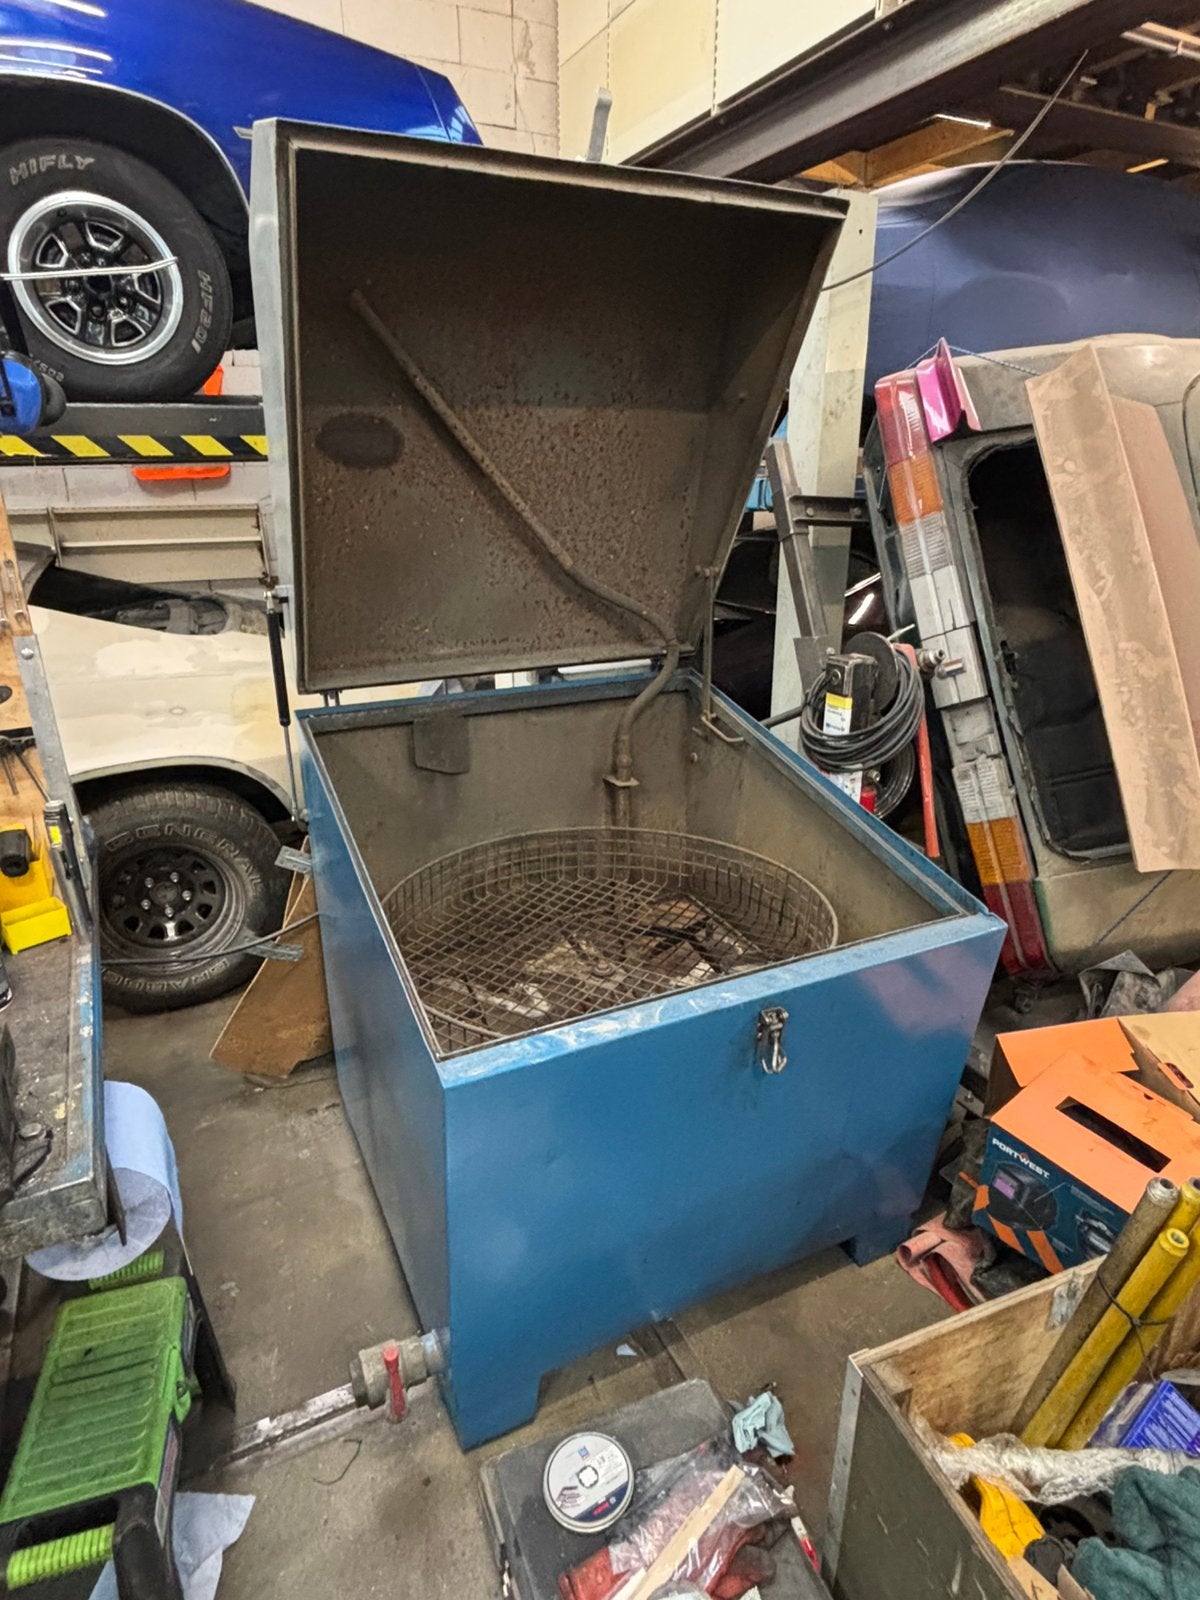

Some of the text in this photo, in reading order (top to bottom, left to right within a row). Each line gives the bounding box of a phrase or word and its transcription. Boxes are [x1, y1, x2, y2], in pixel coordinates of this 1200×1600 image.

[9, 154, 95, 185] HIFLY
[191, 270, 213, 353] HF201
[105, 824, 262, 898] GENERAL
[992, 1137, 1050, 1179] PORTWEST
